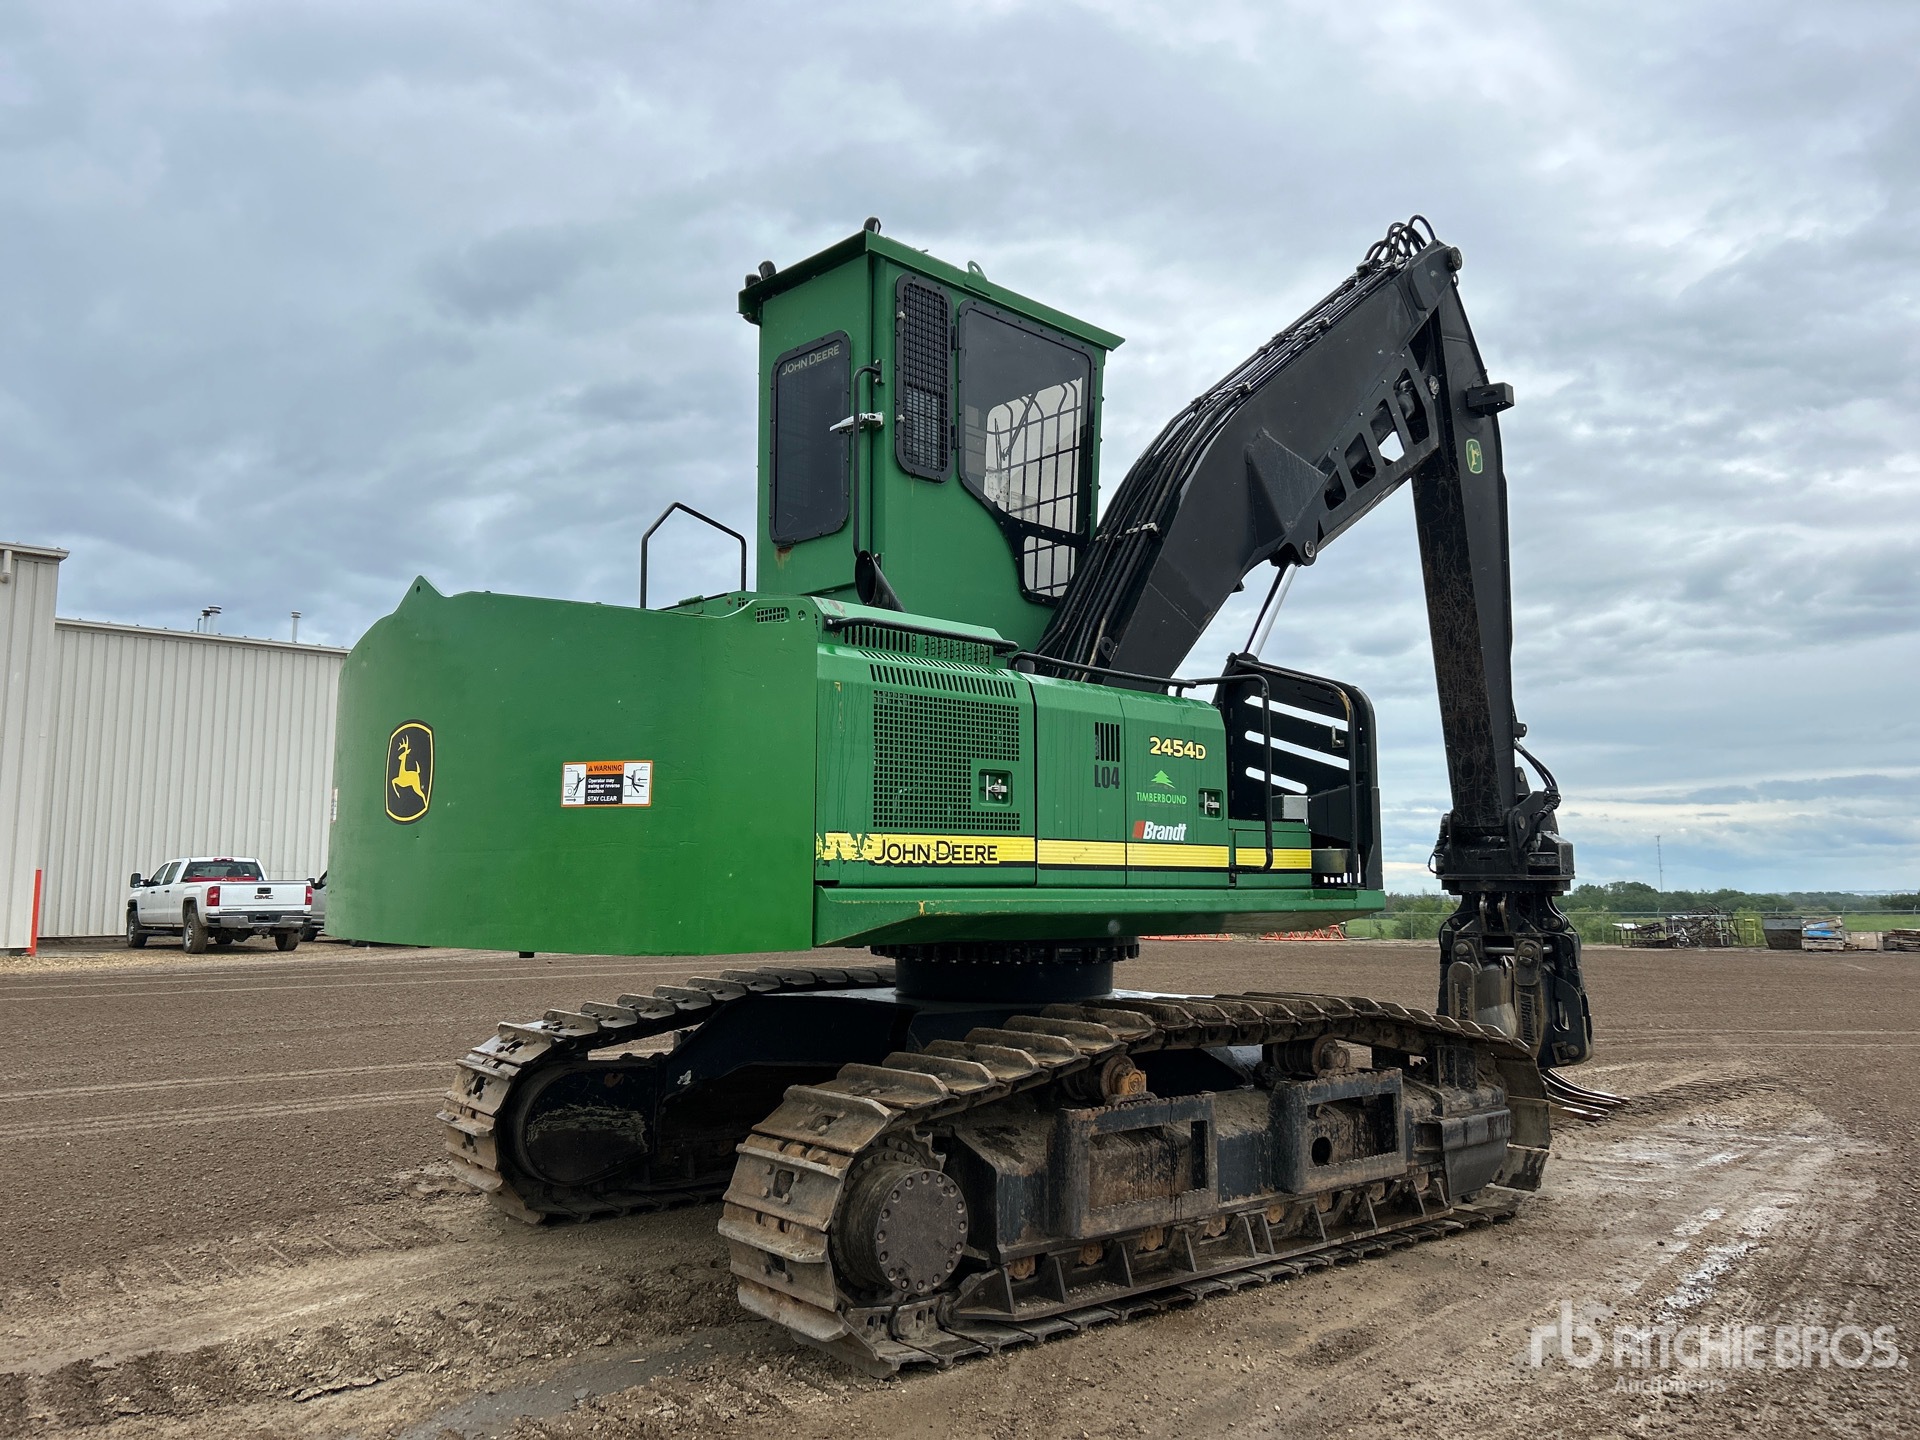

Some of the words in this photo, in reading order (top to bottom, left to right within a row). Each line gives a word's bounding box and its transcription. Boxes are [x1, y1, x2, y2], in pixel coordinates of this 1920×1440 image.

[782, 357, 808, 376] JOHN
[809, 344, 840, 365] DEERE
[1149, 736, 1207, 760] 2454D
[1136, 791, 1187, 805] TIMBERBOUND
[1143, 821, 1187, 841] Brandt
[874, 839, 931, 861] JOHN
[935, 840, 998, 861] DEERE
